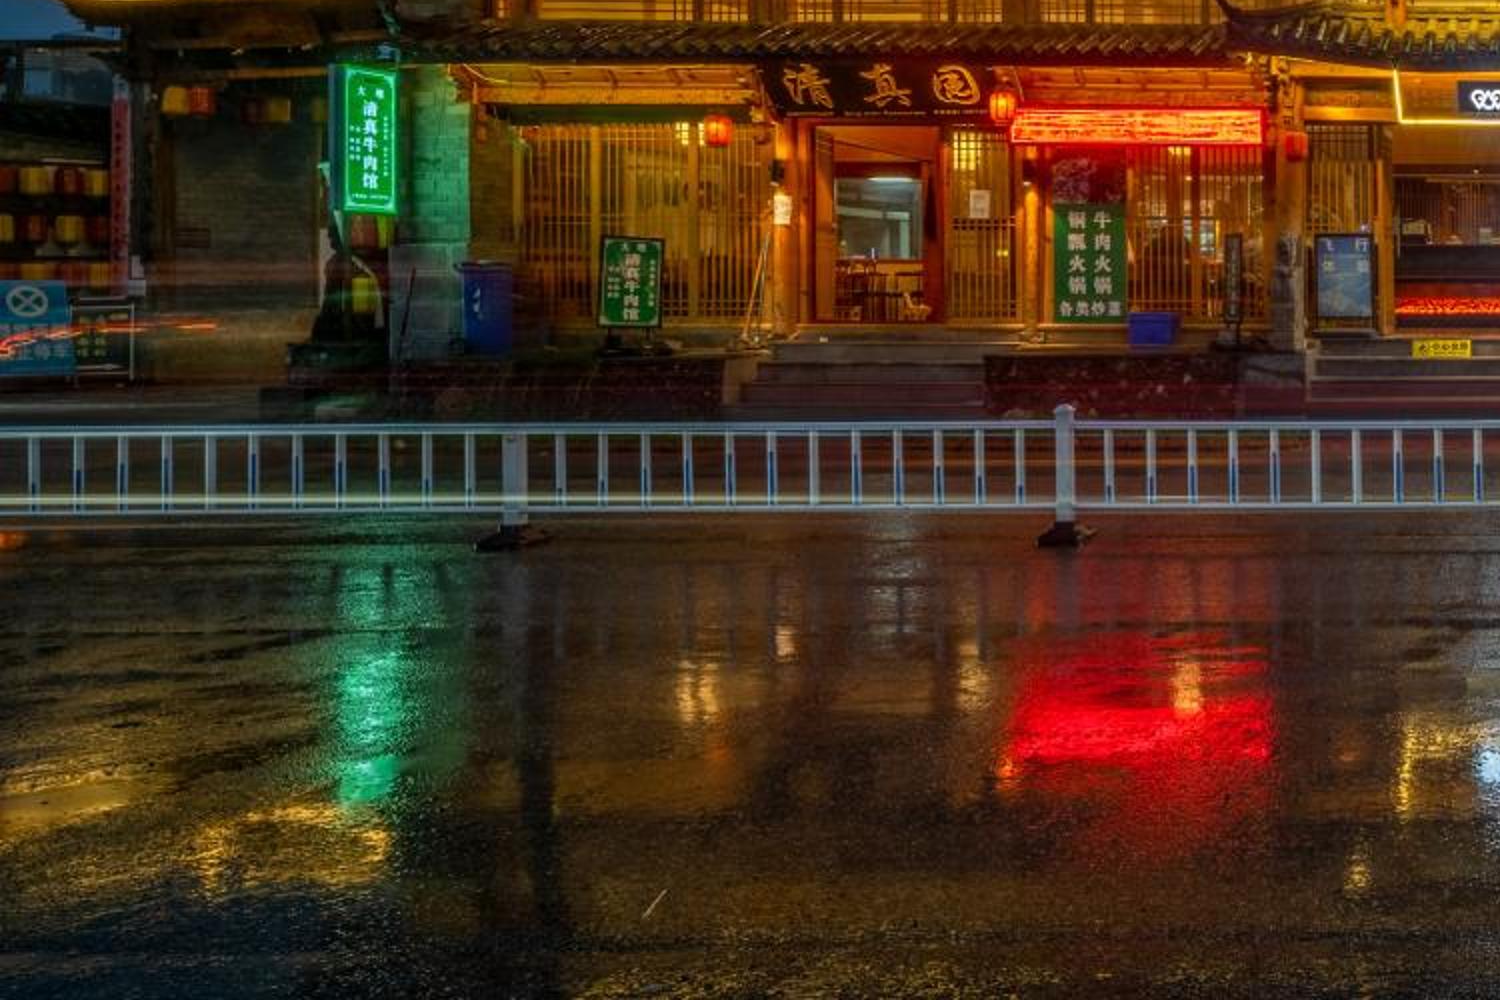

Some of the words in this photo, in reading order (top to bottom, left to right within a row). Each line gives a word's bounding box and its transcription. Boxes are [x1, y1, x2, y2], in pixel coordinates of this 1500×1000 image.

[363, 100, 379, 189] 清真牛肉馆
[1093, 210, 1112, 295] 牛肉火锅
